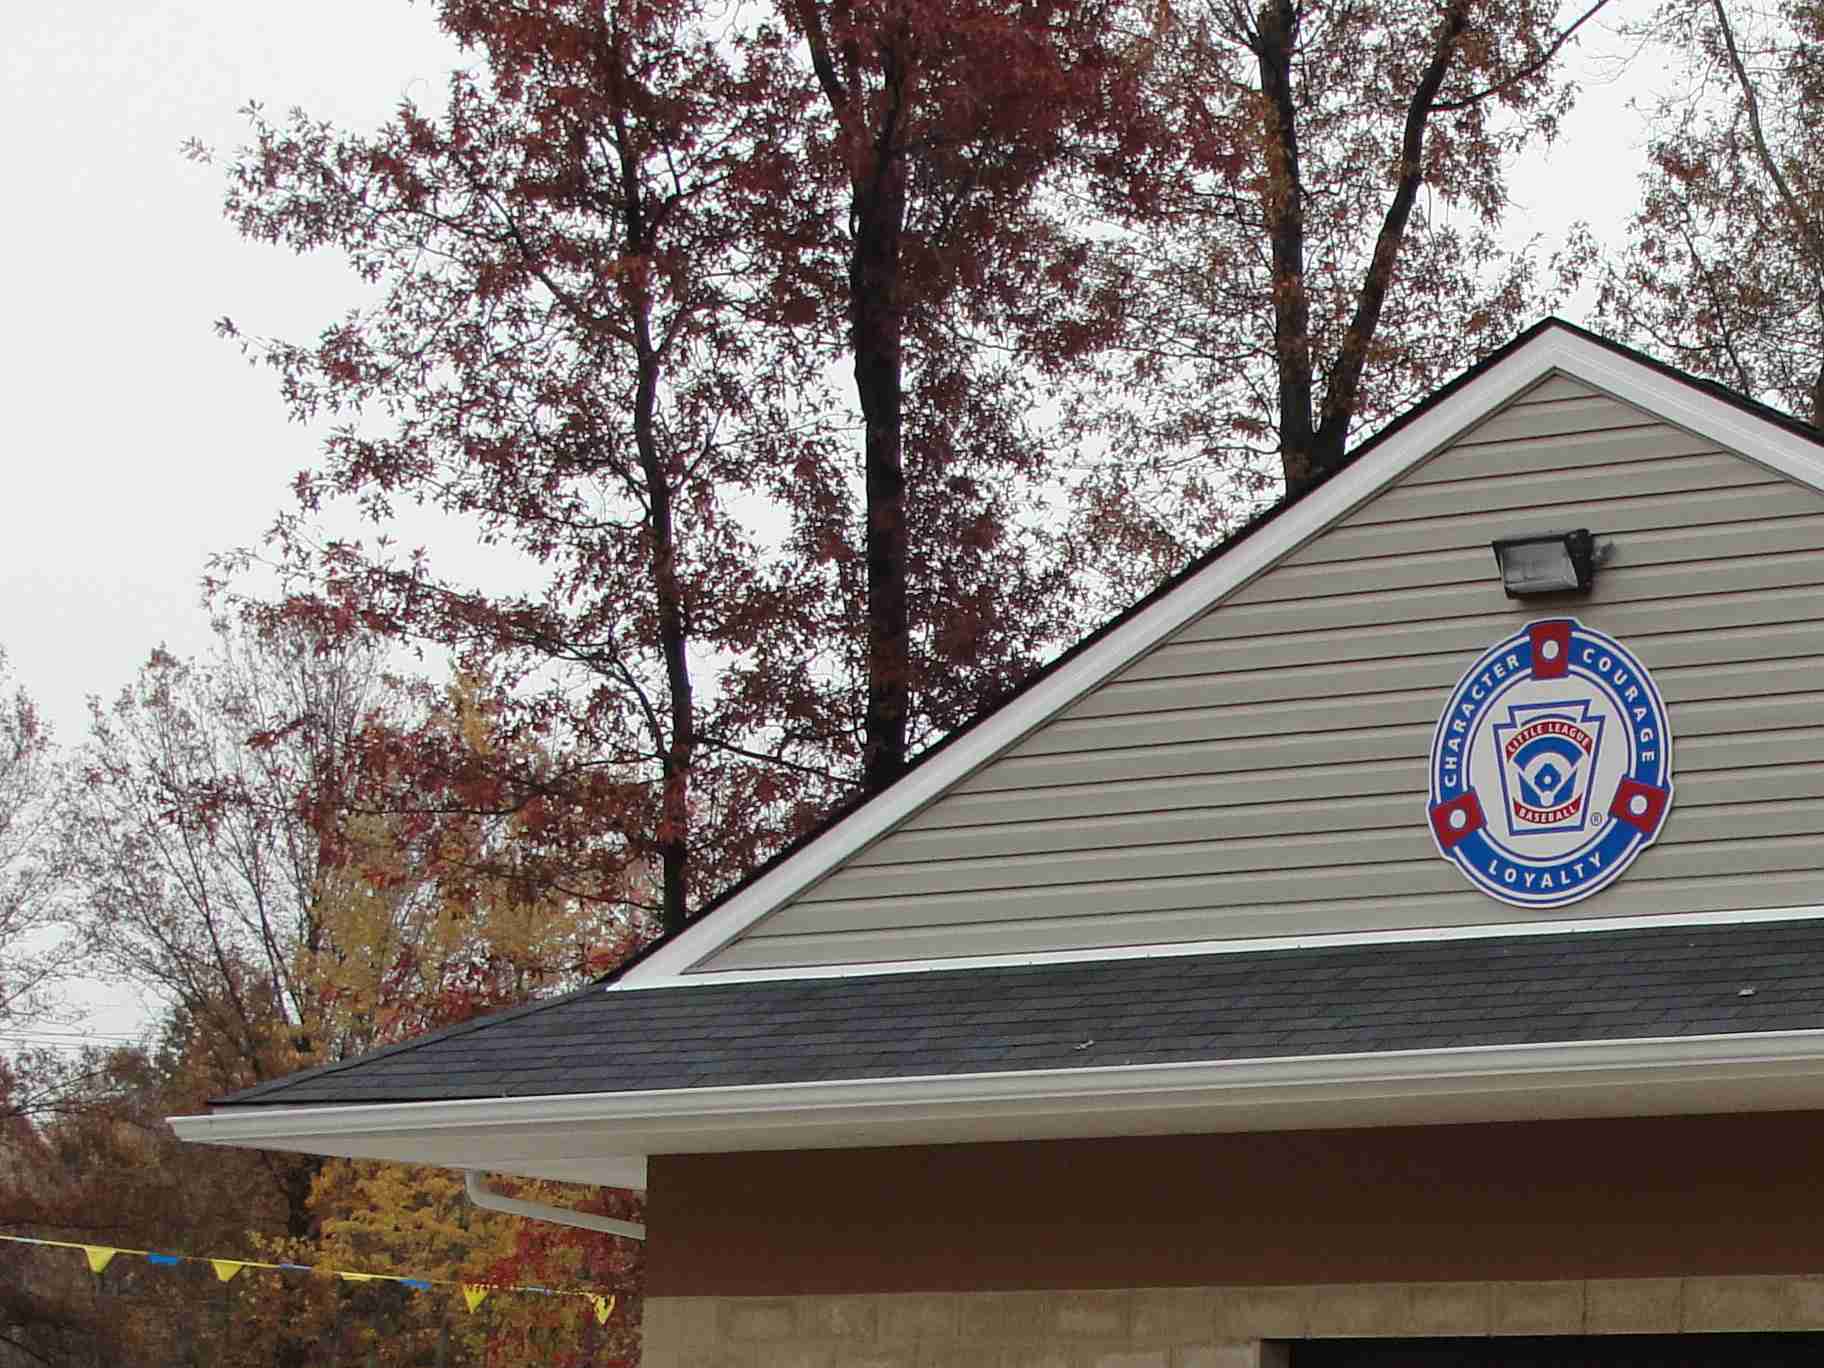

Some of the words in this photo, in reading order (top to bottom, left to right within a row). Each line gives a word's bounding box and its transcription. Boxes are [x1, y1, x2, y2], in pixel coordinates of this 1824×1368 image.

[1443, 654, 1519, 786] CHARACTER
[1582, 648, 1655, 762] COURAGE
[1507, 723, 1543, 752] LITTLE
[1548, 722, 1591, 746] LEAGUE
[1519, 804, 1576, 823] BASEBALL
[1488, 853, 1601, 888] LOYALTY
